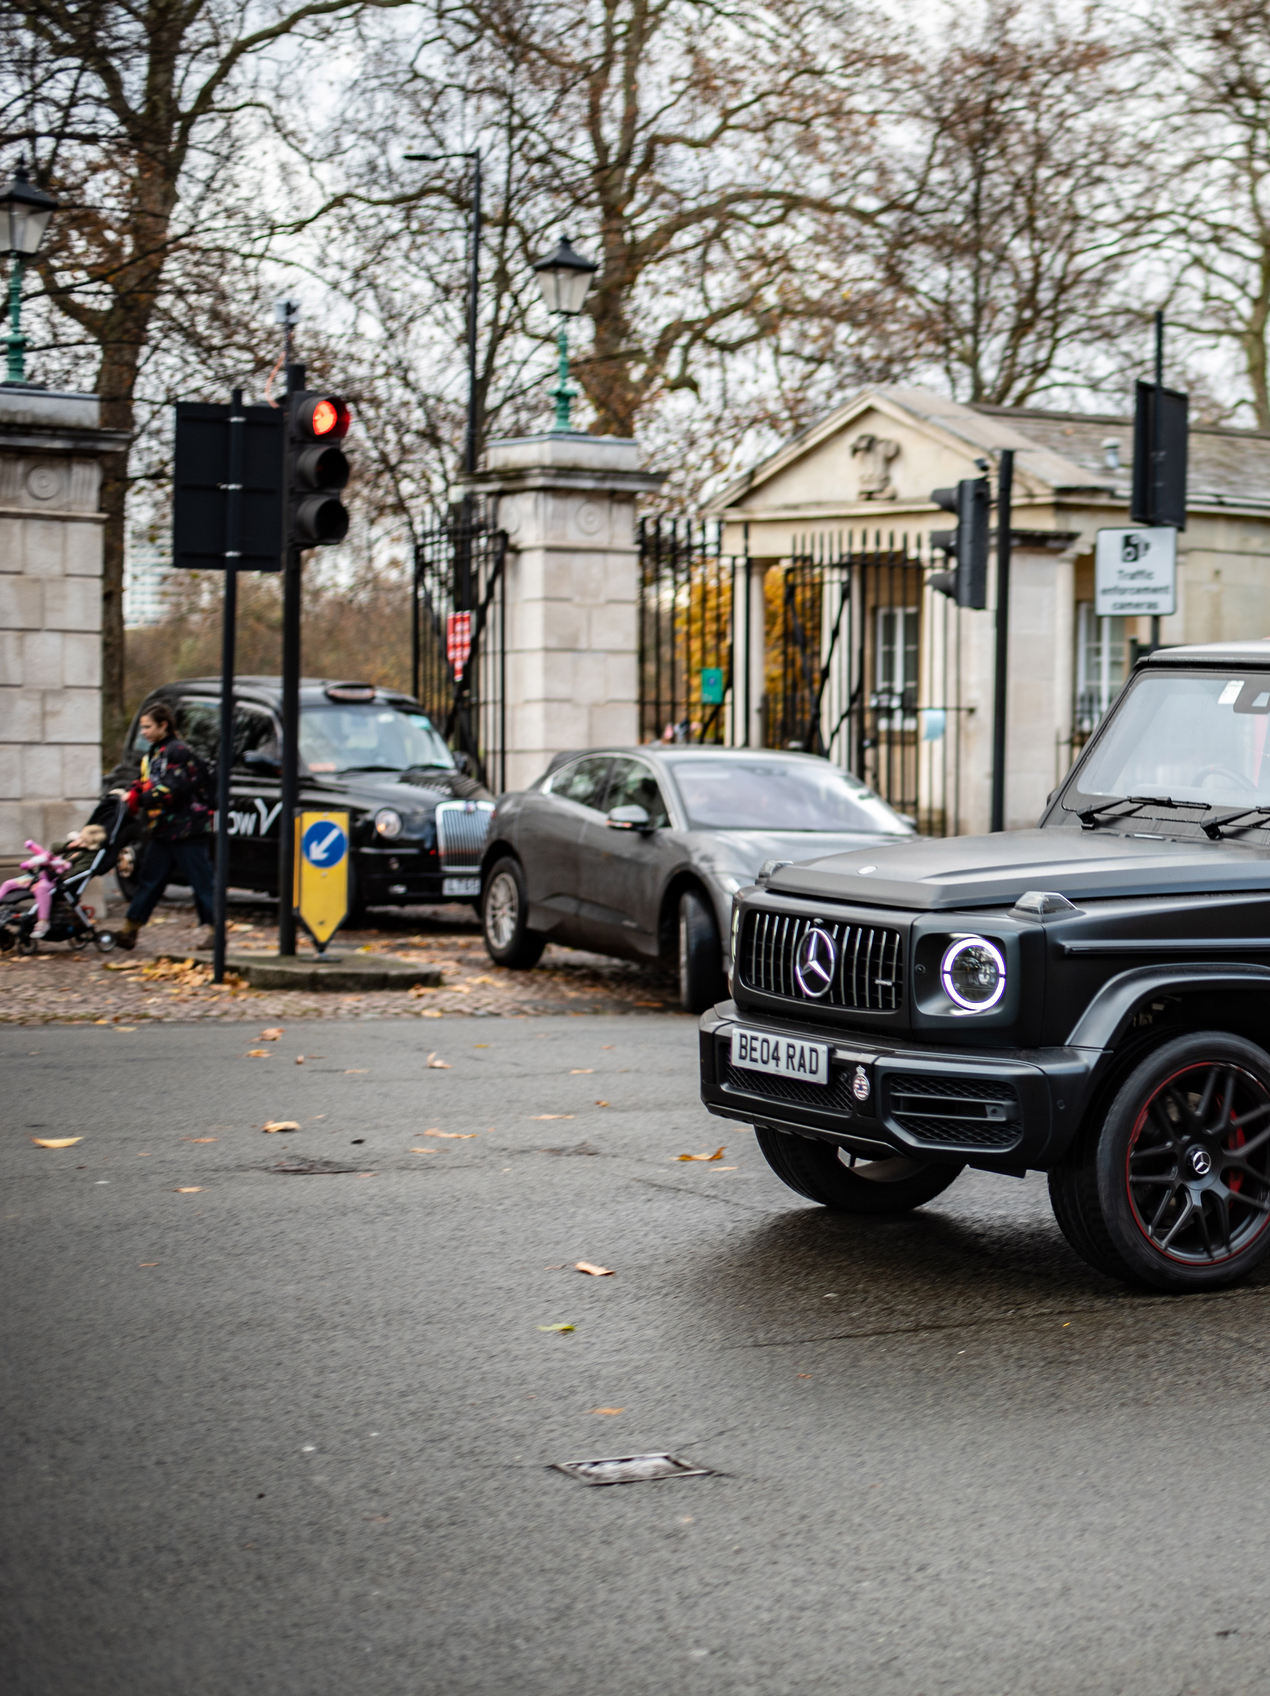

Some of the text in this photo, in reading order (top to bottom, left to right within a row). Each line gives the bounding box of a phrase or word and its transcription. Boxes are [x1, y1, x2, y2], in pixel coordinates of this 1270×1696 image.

[1117, 569, 1155, 581] Traffic
[1101, 585, 1170, 596] enforcement
[1112, 601, 1159, 611] cameras
[738, 1033, 820, 1076] BE04 RAD
